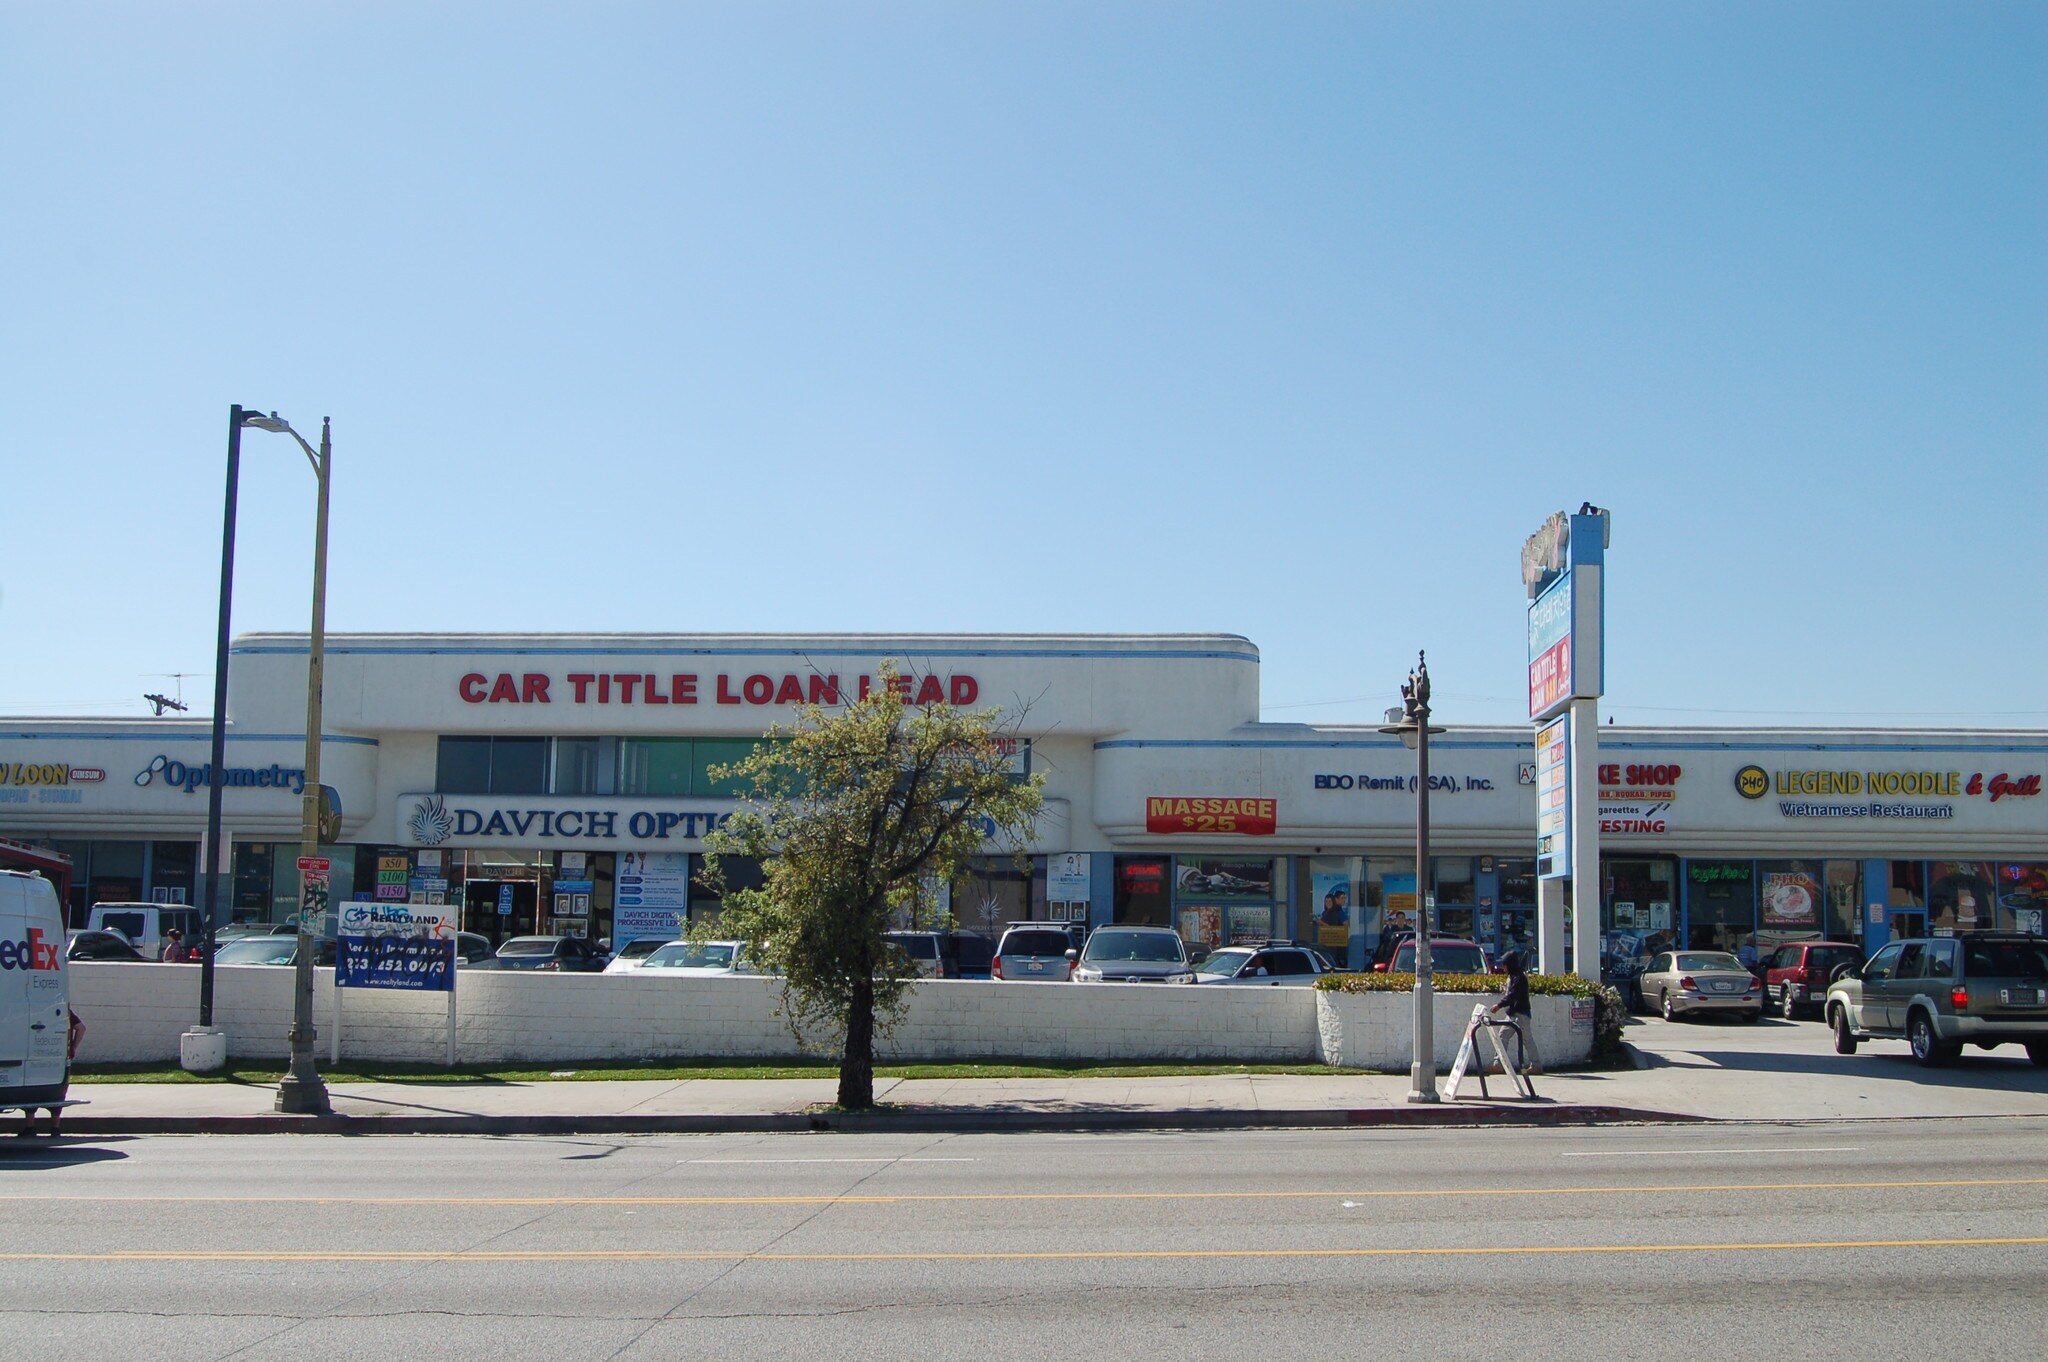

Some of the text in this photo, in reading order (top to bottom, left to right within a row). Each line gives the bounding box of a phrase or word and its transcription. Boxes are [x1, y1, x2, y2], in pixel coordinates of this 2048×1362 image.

[1541, 651, 1556, 680] TITLE
[459, 673, 979, 706] CAR TITLE LOAN LEAD
[1626, 764, 1682, 785] SHOP
[1314, 775, 1495, 793] BDO Remit (SA), Inc.
[1742, 770, 2042, 802] PHO LEGEND NOODLE & Grill
[1150, 798, 1273, 819] MASSAGE
[1779, 802, 1954, 818] Vietnamese Restaurant
[454, 809, 618, 838] DAVICH
[1181, 815, 1237, 833] $25
[1599, 819, 1666, 833] ESTING
[385, 858, 401, 869] $50
[381, 872, 404, 884] $100
[1770, 872, 1808, 886] PHO
[378, 885, 403, 899] $150
[617, 919, 664, 927] PROGRESSIVE
[33, 975, 59, 989] Express
